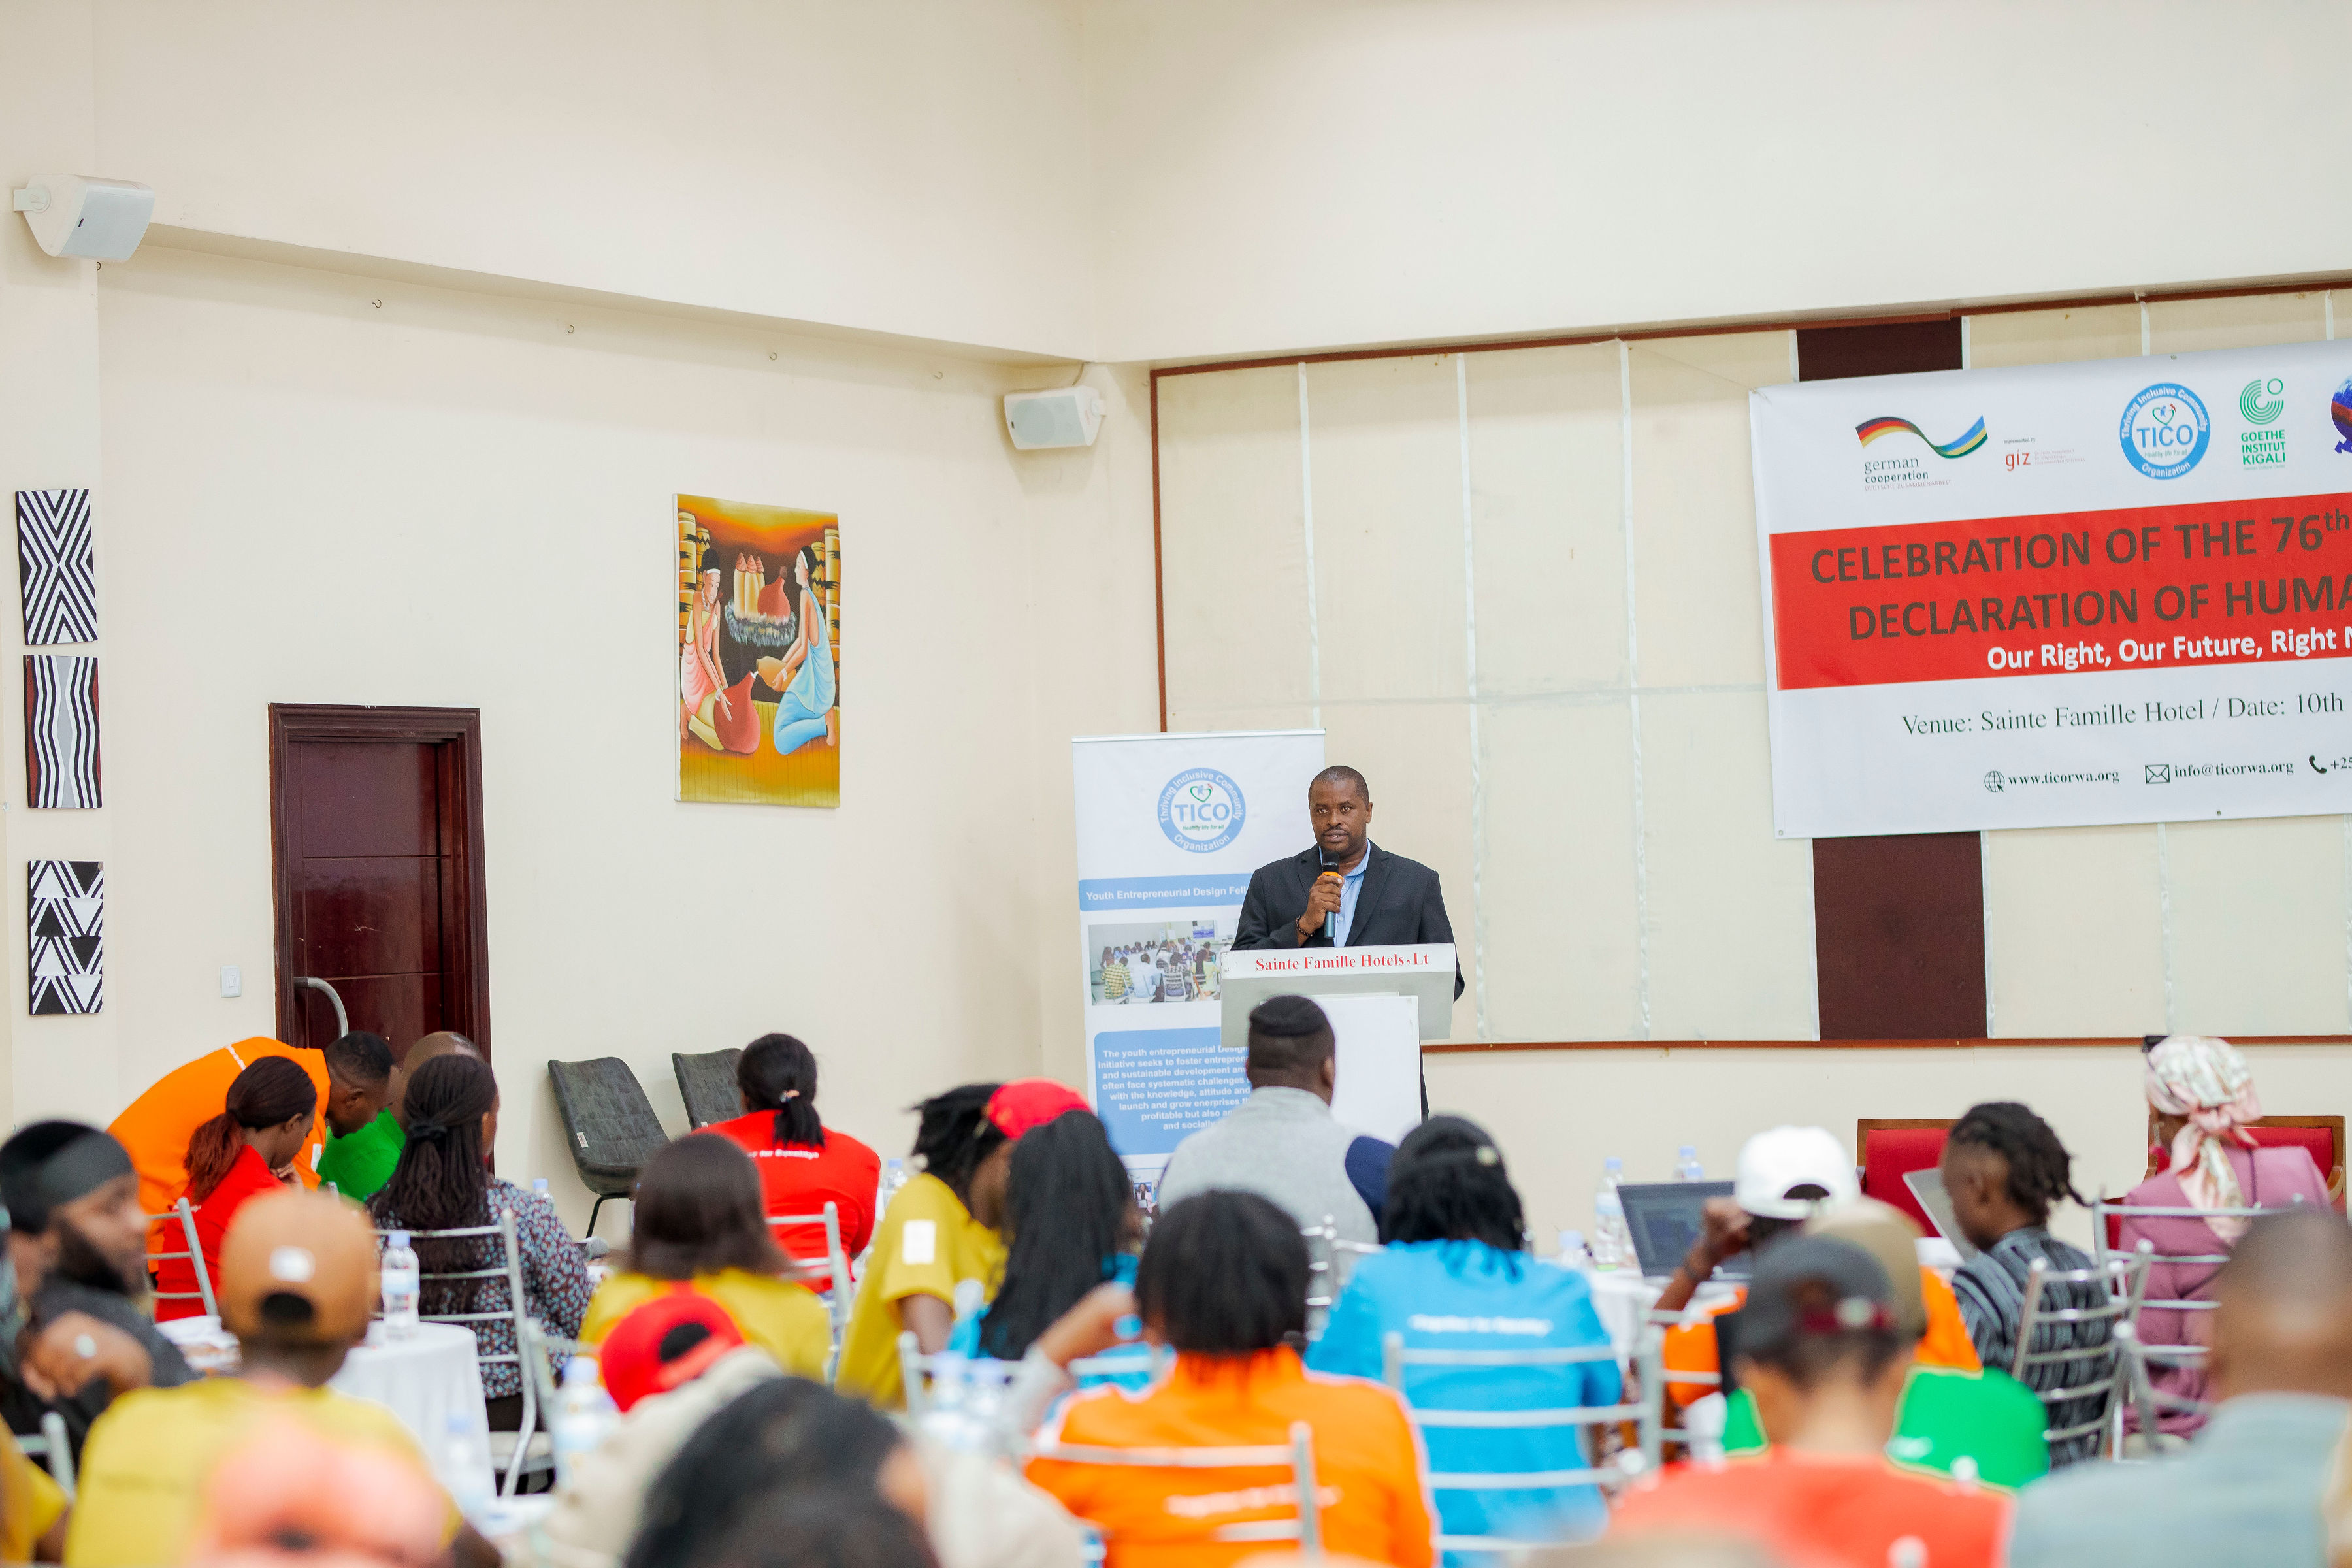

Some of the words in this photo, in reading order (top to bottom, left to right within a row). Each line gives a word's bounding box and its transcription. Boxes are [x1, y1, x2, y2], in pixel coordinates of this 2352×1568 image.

[2121, 402, 2141, 440] Thriving
[2137, 386, 2176, 404] Inclusive
[2178, 389, 2208, 433] Community
[2136, 425, 2193, 448] TICO
[2241, 429, 2285, 442] GOETHE
[2242, 441, 2286, 453] INSTITUT
[1864, 457, 1919, 475] german
[2005, 449, 2031, 472] giz
[2243, 452, 2285, 465] KIGALI
[1865, 470, 1929, 483] cooperation
[2142, 461, 2191, 478] Organization
[1812, 531, 2091, 584] CELEBRATION
[2106, 527, 2161, 564] OF
[2174, 519, 2257, 559] THE
[2271, 508, 2350, 553] 76th
[1849, 589, 2138, 641] DECLARATION
[2154, 583, 2210, 621] OF
[1987, 646, 2034, 670] Our
[2040, 641, 2112, 671] Right,
[2119, 639, 2166, 662] Our
[2173, 636, 2263, 660] Future,
[2271, 626, 2337, 657] Right
[1902, 715, 1972, 735] Venue:
[1981, 710, 2047, 732] Sainte
[2054, 703, 2136, 728] Famille
[2144, 699, 2204, 723] Hotel
[2212, 697, 2219, 719] /
[2227, 697, 2285, 718] Date:
[2298, 691, 2345, 714] 10th
[2174, 761, 2295, 778] info@ticorwa.org
[2008, 771, 2120, 785] www.ticorwa.org
[1160, 786, 1176, 823] Thriving
[1173, 770, 1214, 787] Inclusive
[1215, 774, 1244, 821] Community
[1174, 803, 1230, 822] TICO
[1174, 834, 1230, 851] Organization
[1086, 891, 1115, 901] Youth
[1117, 889, 1191, 900] Entrepreneurial
[1193, 886, 1226, 898] Design
[1229, 885, 1248, 894] Fell
[1255, 958, 1299, 972] Sainte
[1304, 955, 1356, 970] Famille
[1122, 1049, 1147, 1059] youth
[1149, 1045, 1216, 1056] entrepreneurial
[1098, 1060, 1135, 1069] initiative
[1102, 1071, 1119, 1079] and
[1121, 1068, 1171, 1079] sustainable
[1174, 1066, 1230, 1077] development
[1102, 1081, 1125, 1090] often
[1127, 1081, 1146, 1089] face
[1148, 1079, 1196, 1090] systematic
[1198, 1076, 1245, 1086] challenges
[1109, 1092, 1129, 1100] with
[1131, 1091, 1145, 1100] the
[1147, 1089, 1197, 1100] knowledge,
[1199, 1087, 1232, 1096] attitude
[1119, 1102, 1149, 1111] launch
[1151, 1101, 1168, 1109] and
[1169, 1102, 1192, 1110] grow
[1141, 1111, 1183, 1122] profitable
[1184, 1110, 1200, 1119] but
[1201, 1109, 1220, 1118] also
[1162, 1121, 1179, 1130] and
